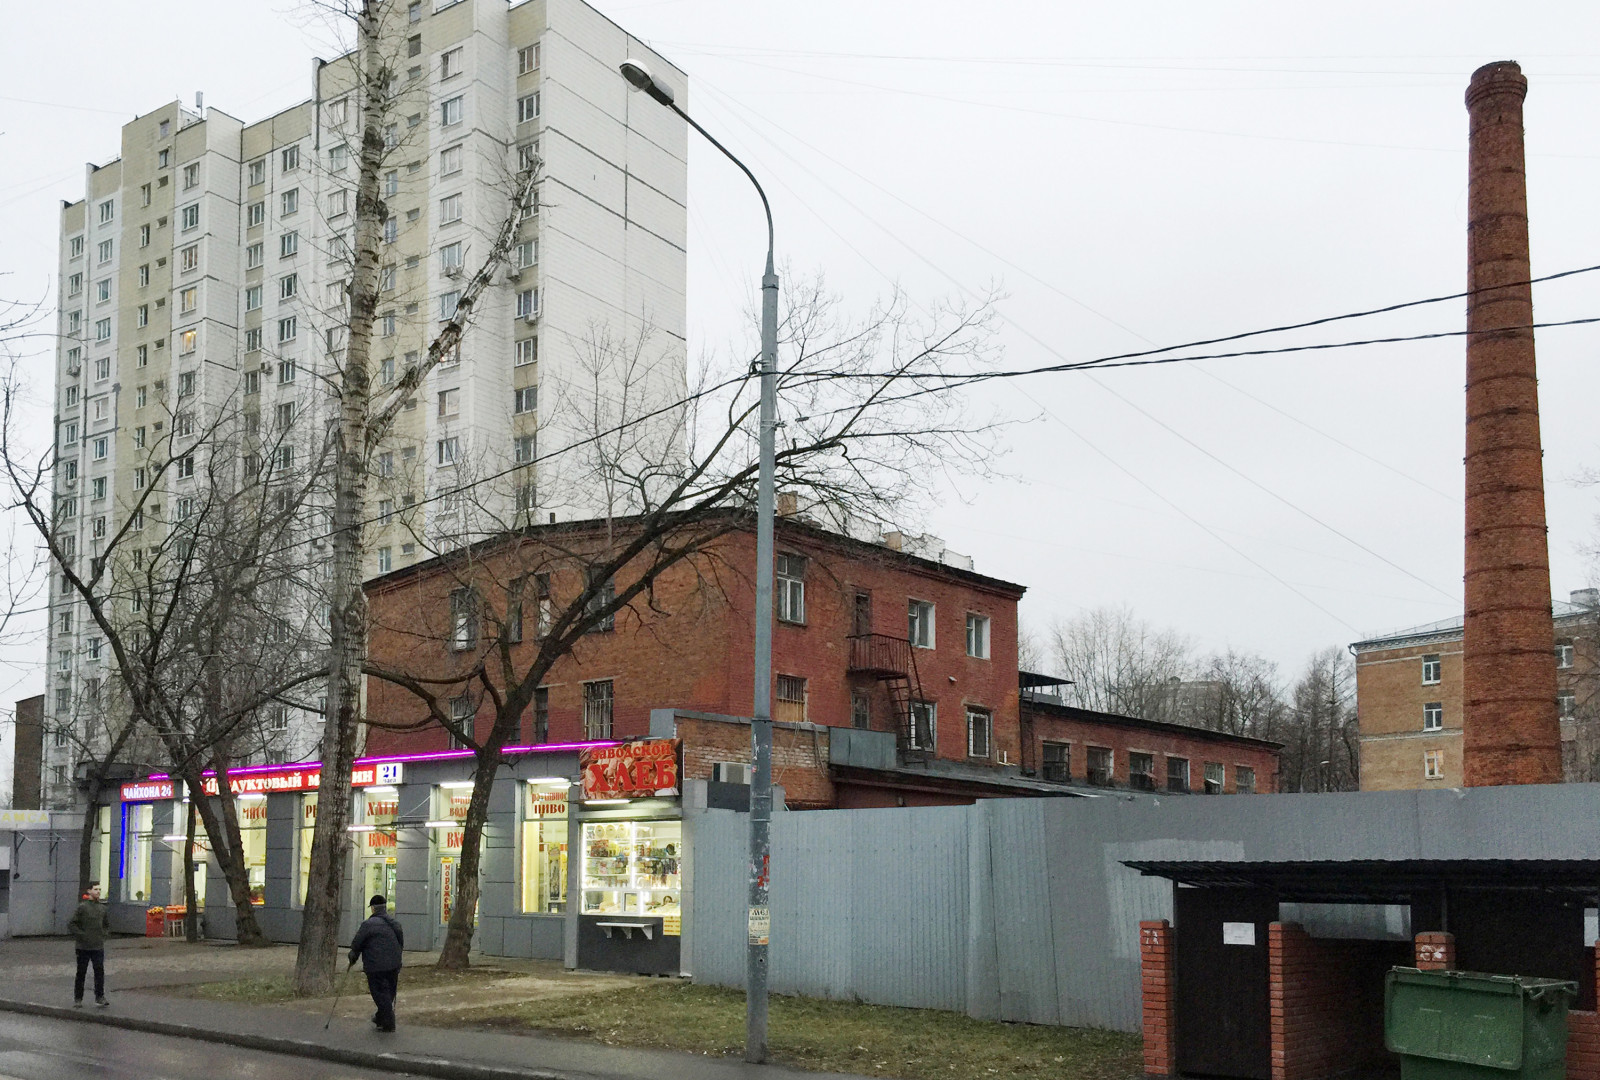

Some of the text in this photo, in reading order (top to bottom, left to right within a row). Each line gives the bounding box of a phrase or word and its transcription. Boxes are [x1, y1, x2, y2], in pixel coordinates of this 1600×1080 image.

[588, 760, 675, 793] ХЛЕБ
[123, 784, 160, 799] ЧАЙХОНА
[534, 803, 566, 815] ПИВО
[368, 833, 397, 848] ВХОД
